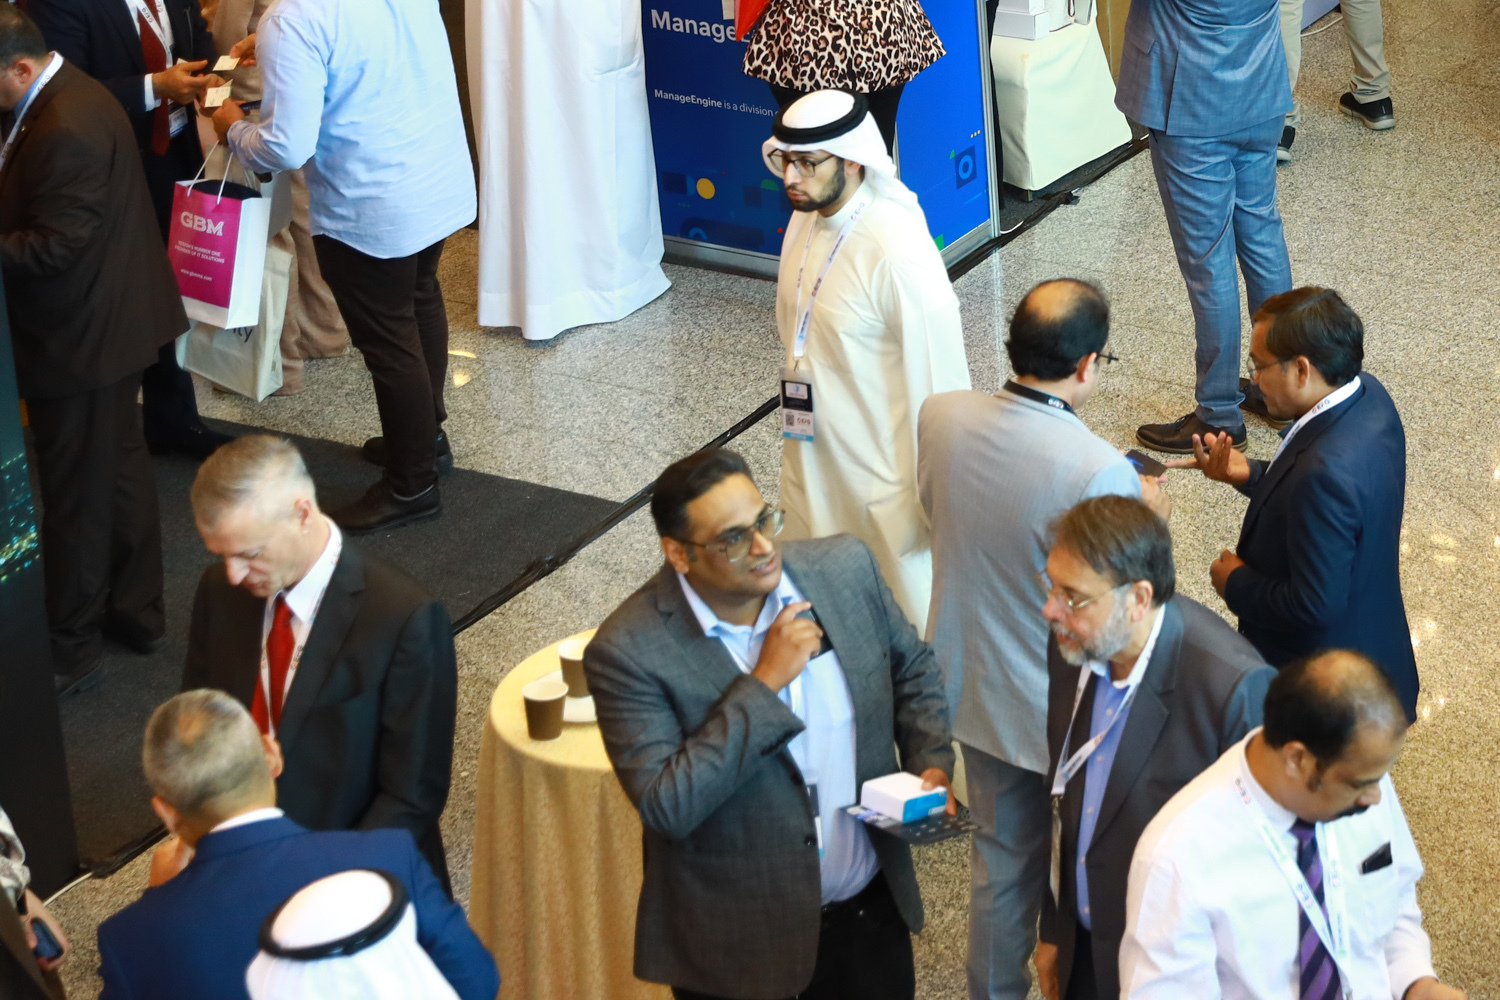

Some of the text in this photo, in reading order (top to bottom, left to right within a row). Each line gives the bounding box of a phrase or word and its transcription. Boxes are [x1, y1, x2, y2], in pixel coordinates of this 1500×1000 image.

[651, 9, 750, 43] Manage
[654, 89, 722, 108] ManageEngine
[724, 100, 731, 109] is
[732, 103, 738, 111] a
[740, 103, 773, 117] division
[180, 211, 225, 237] GBM
[201, 254, 225, 264] SOLUTIONS
